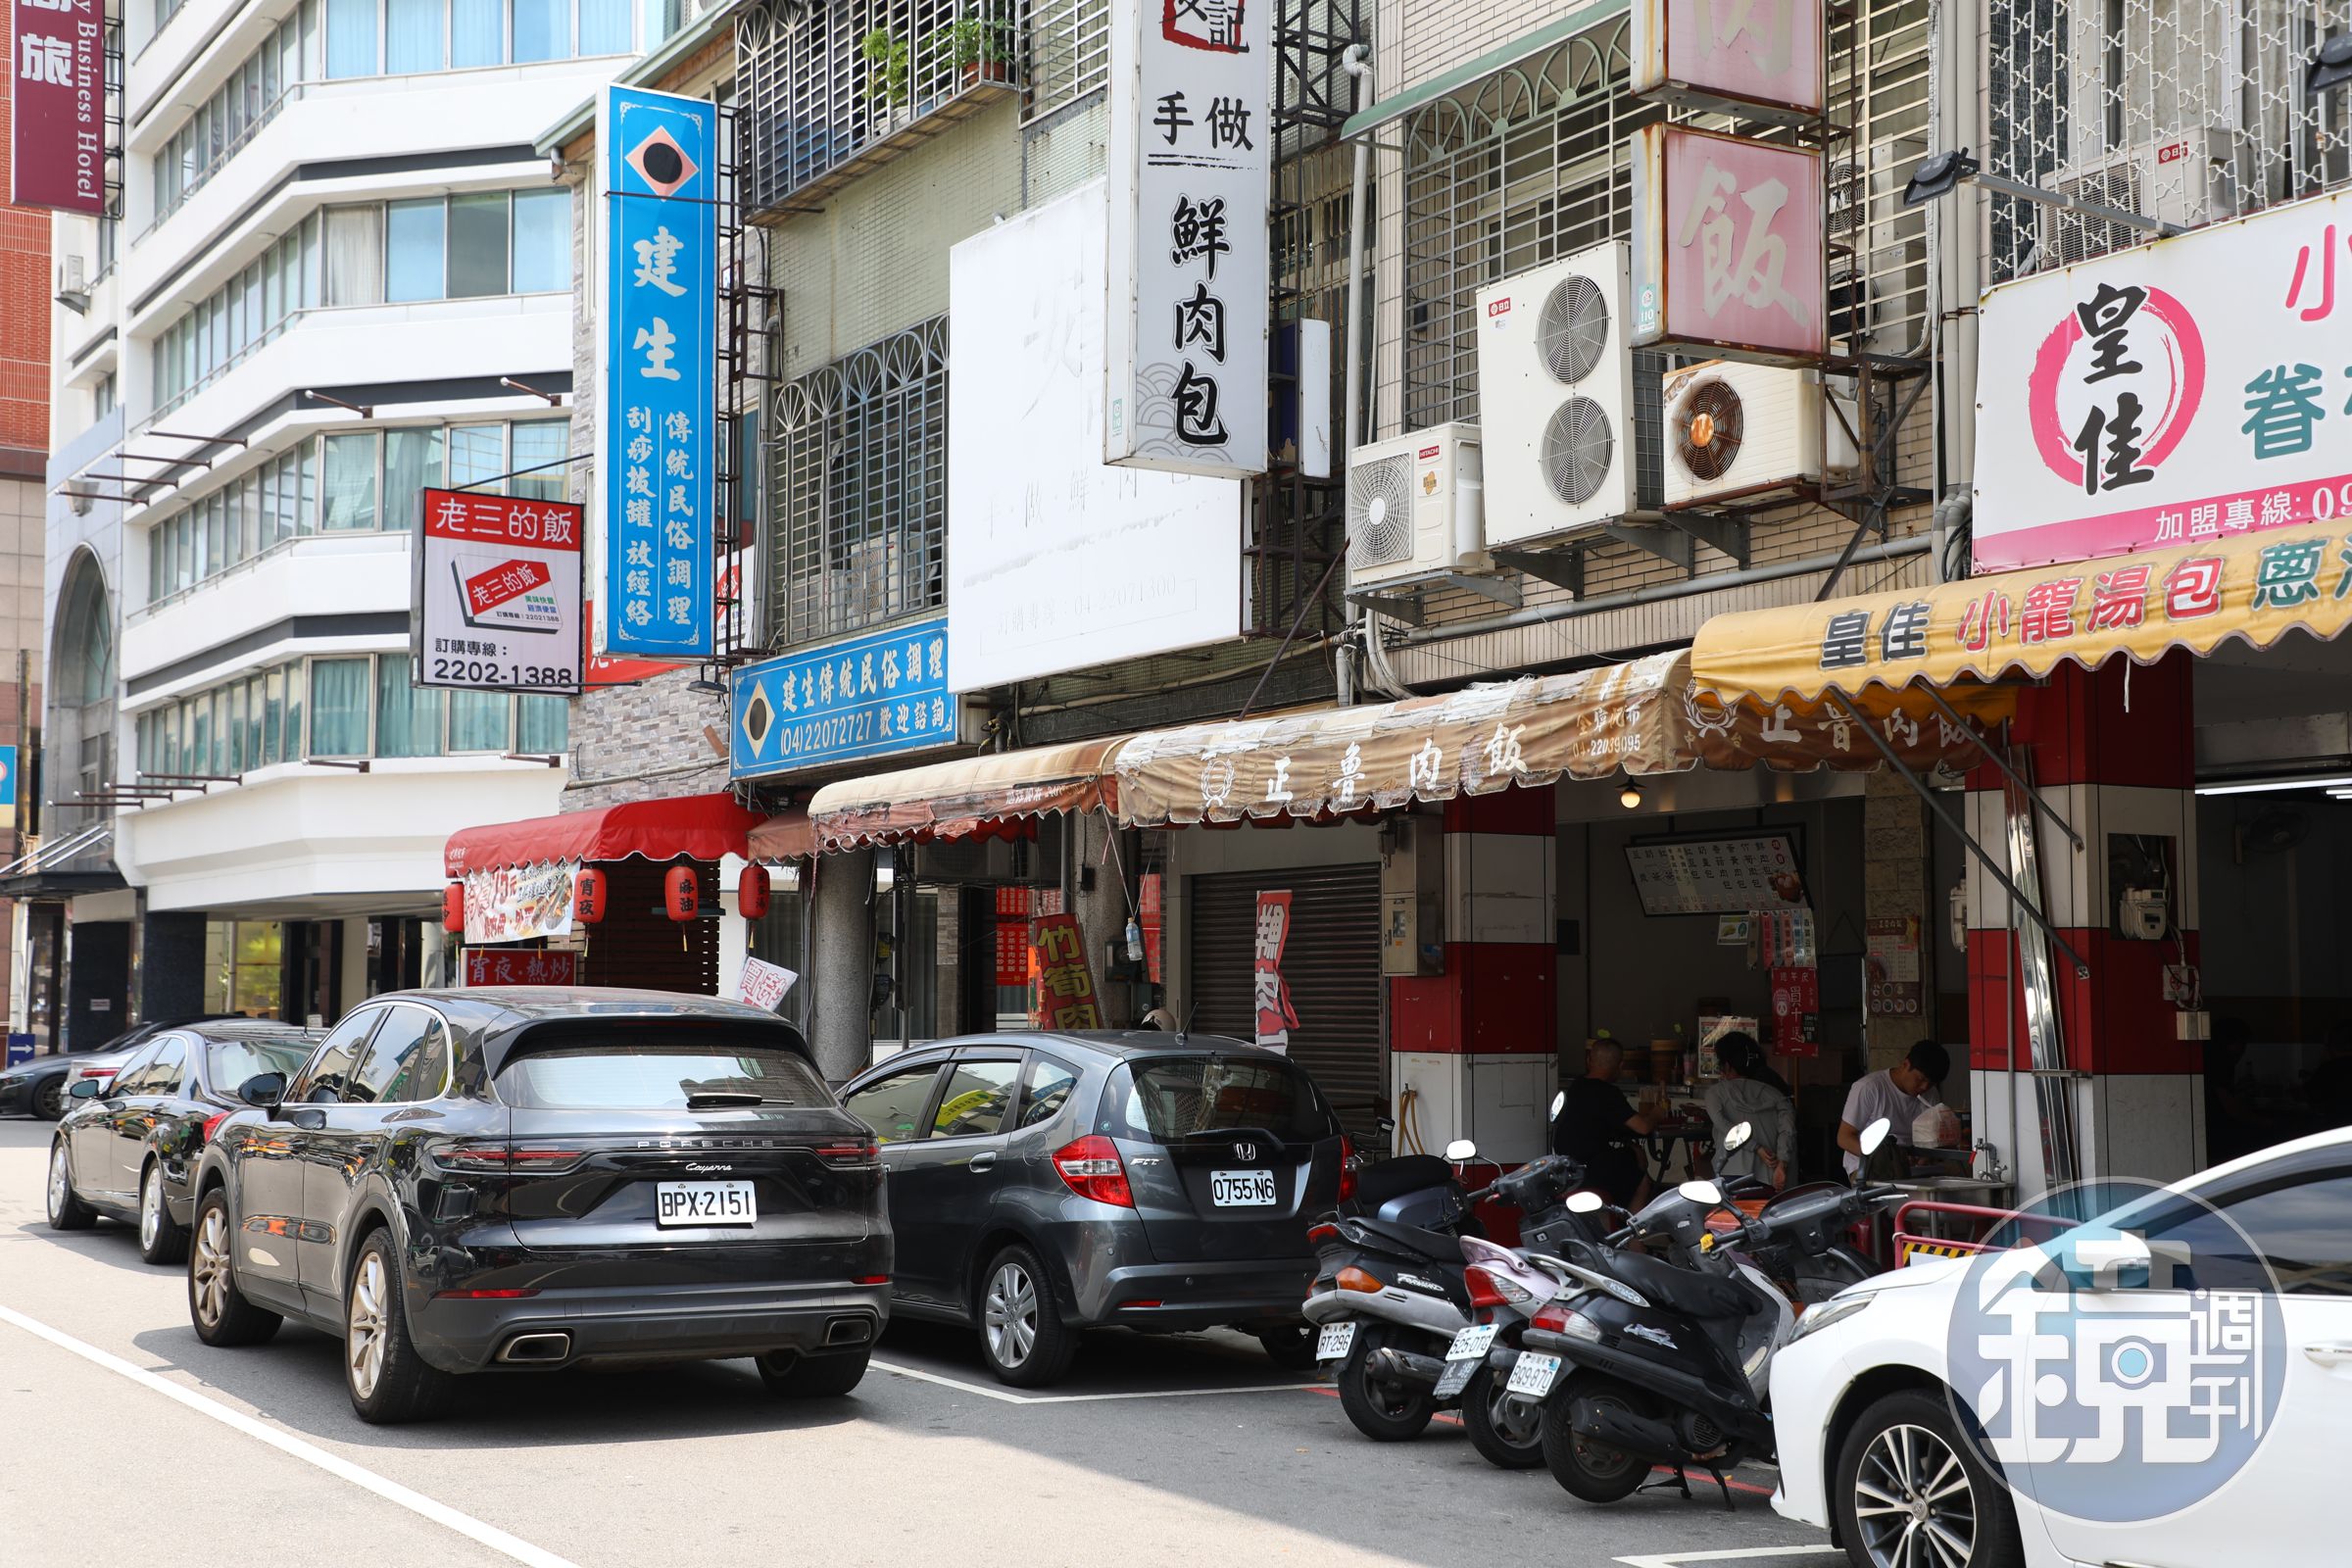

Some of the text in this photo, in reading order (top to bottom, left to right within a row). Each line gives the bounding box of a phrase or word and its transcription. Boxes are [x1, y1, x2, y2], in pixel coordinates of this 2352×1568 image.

[15, 0, 73, 87] 旅
[77, 20, 98, 123] Business
[1152, 92, 1254, 151] 手做
[77, 130, 98, 199] Hotel
[1678, 158, 1810, 328] 飯
[2284, 224, 2352, 322] 小
[633, 226, 688, 381] 建生
[1171, 196, 1231, 446] 鮮肉包
[2074, 282, 2154, 496] 皇佳
[2240, 362, 2352, 461] 眷
[1419, 446, 1439, 458] HITACHI
[436, 497, 573, 544] 老三的飯
[626, 406, 657, 626] 刮痧拔罐 放經絡
[665, 411, 695, 626] 傳統民俗調理
[472, 564, 540, 607] 老三的飯
[1820, 600, 1933, 671] 皇佳
[1956, 555, 2226, 654] 小籠湯包
[434, 659, 572, 688] 2202-1388
[782, 637, 944, 713] 建生傳統民俗調理
[780, 695, 945, 757] (04)22072727 歡迎諮詢
[1265, 722, 1529, 804] 正魯肉飯
[579, 878, 596, 915] 宵夜
[637, 1140, 774, 1149] PORSCHE
[686, 1161, 733, 1173] Cayenne
[1609, 1282, 1641, 1304] KYMCO
